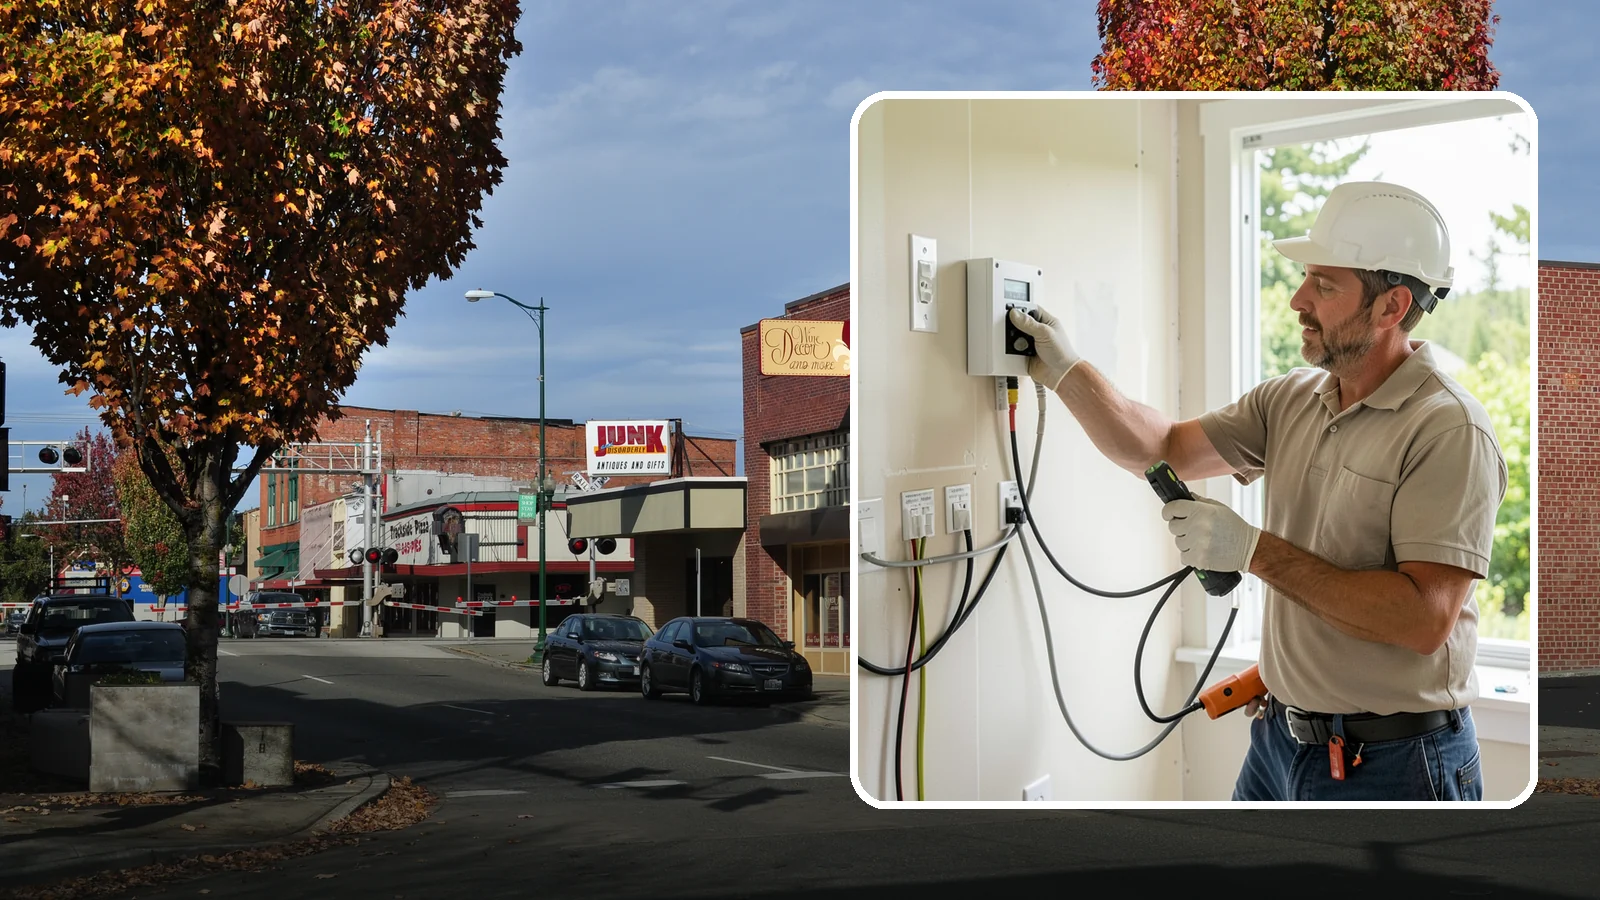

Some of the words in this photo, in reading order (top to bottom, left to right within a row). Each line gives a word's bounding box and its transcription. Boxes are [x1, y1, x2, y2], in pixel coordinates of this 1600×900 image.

[595, 424, 664, 457] JUNK
[607, 446, 646, 454] DISORDERLY
[596, 460, 628, 470] ANTIQUES
[631, 460, 644, 470] AND
[647, 460, 665, 470] GIFTS
[414, 519, 429, 535] Pizza
